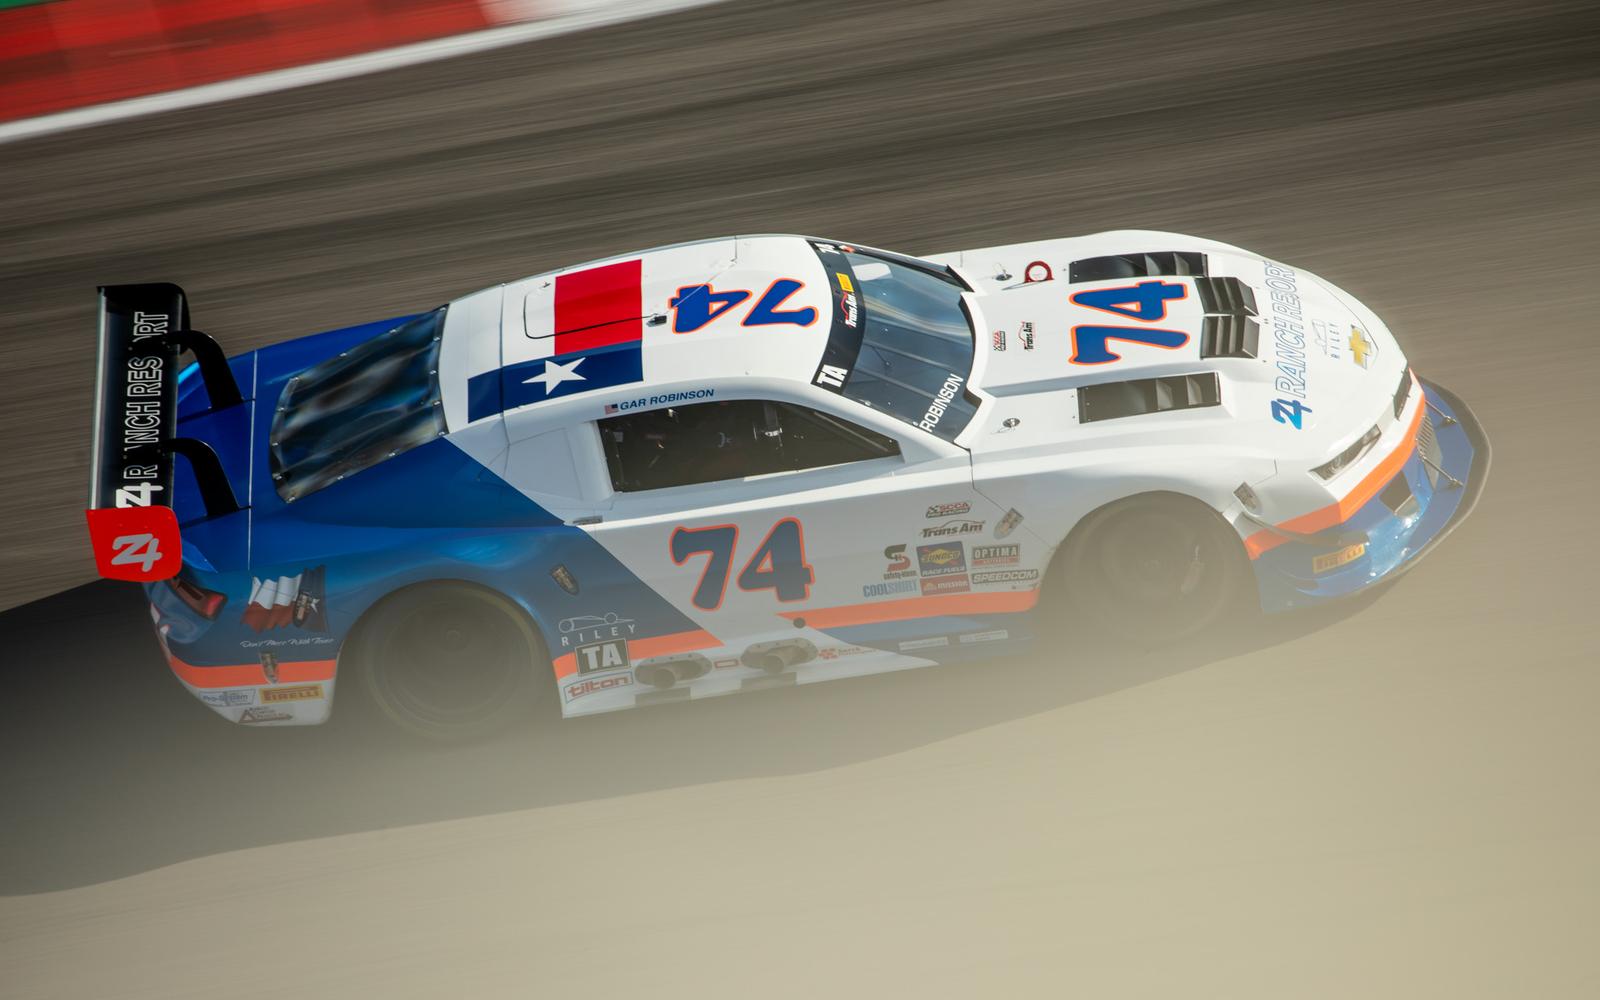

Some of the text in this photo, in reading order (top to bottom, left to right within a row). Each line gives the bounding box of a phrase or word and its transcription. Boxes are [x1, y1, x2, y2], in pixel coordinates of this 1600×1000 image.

[668, 277, 819, 334] 74
[1068, 280, 1190, 365] 74
[127, 311, 168, 397] RESRT
[1273, 316, 1306, 399] RANCH
[816, 364, 848, 388] TA
[620, 389, 714, 411] GAR ROBINSON
[919, 373, 964, 432] ROBINSON
[123, 401, 161, 479] RNCH
[922, 523, 983, 538] Trans Am
[669, 517, 815, 612] 74
[974, 546, 1017, 559] OPTIMA
[974, 570, 1037, 583] SPEEDCOM
[561, 624, 635, 646] RILEY
[582, 643, 623, 670] TA
[263, 686, 320, 701] PIRELLI
[568, 677, 628, 697] tilton
